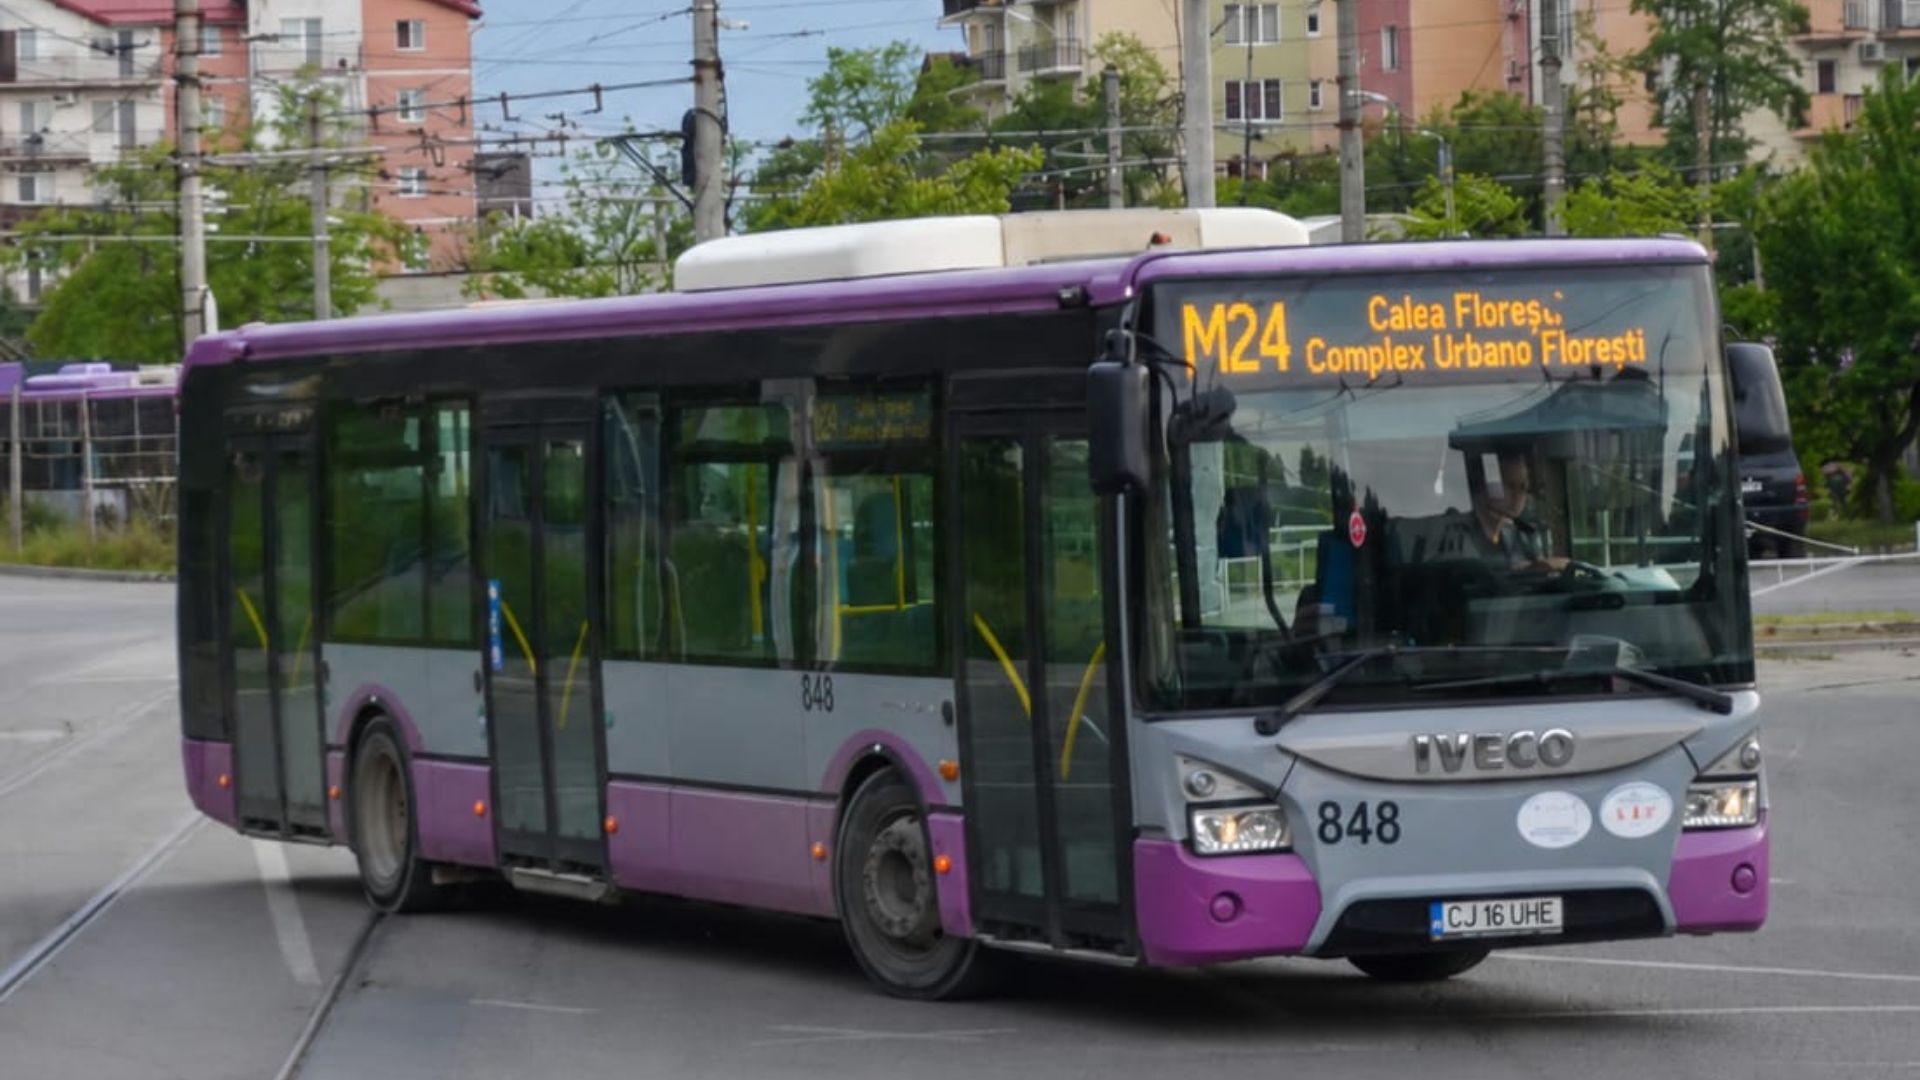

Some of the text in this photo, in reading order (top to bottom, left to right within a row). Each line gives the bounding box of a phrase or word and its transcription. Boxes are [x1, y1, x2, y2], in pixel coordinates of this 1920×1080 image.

[1368, 294, 1446, 332] Calea
[1183, 300, 1291, 381] M24
[1305, 335, 1426, 381] Complex
[1432, 332, 1533, 369] Urbano
[802, 673, 834, 713] 848
[1413, 728, 1575, 774] IVECO
[1317, 800, 1401, 845] 848
[1447, 904, 1477, 928] CJ
[1484, 904, 1505, 926] 16
[1510, 901, 1554, 926] UHE
